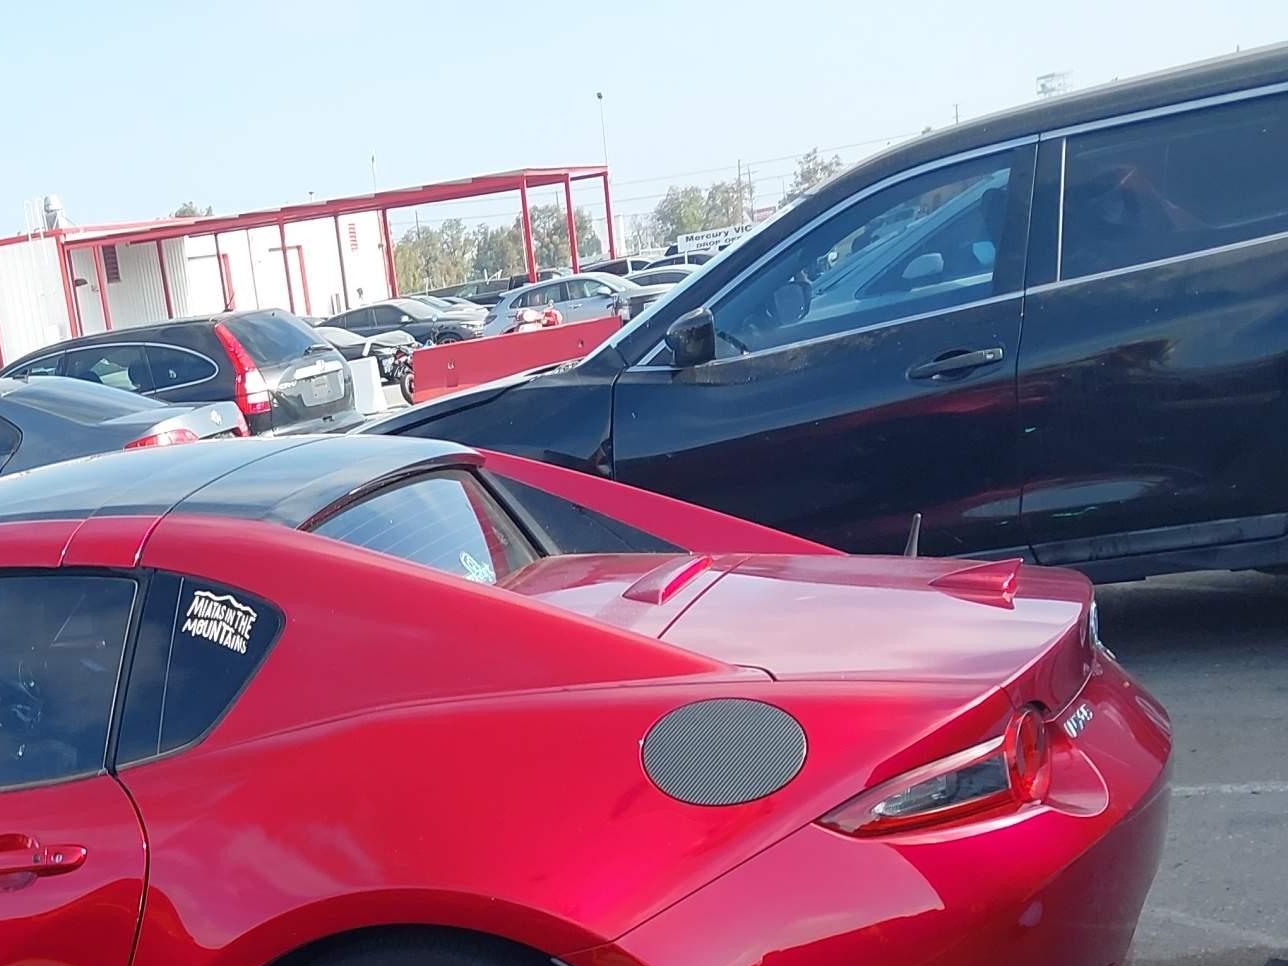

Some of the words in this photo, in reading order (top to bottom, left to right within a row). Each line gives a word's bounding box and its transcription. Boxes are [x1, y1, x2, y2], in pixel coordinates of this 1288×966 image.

[685, 230, 729, 243] Mercury
[696, 239, 721, 249] DROP
[186, 595, 226, 620] MIATAS
[225, 607, 237, 627] IN
[234, 610, 257, 640] THE
[181, 617, 248, 655] MOUNTAINS
